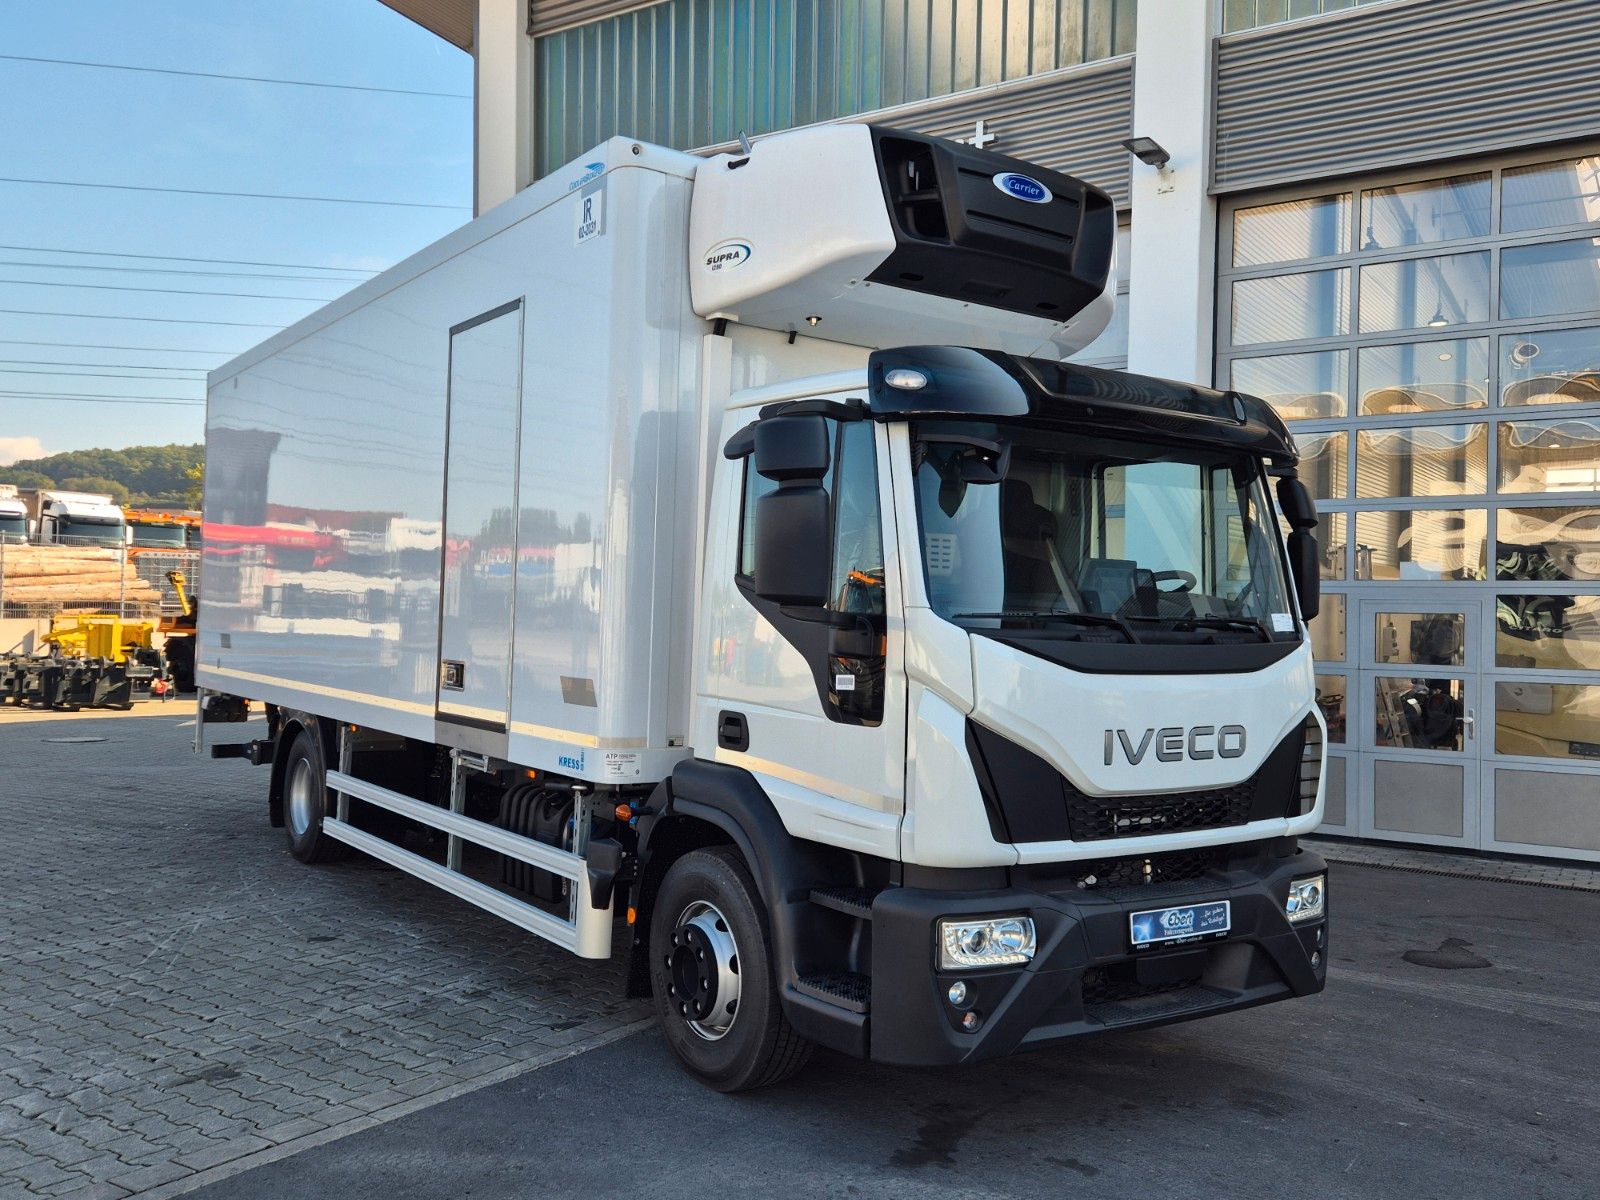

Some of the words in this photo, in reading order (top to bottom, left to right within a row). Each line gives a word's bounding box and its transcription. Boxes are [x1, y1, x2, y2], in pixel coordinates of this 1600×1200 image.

[1008, 179, 1040, 196] Carrier
[583, 197, 592, 224] IR
[706, 251, 740, 266] SUPRA
[1103, 724, 1247, 766] IVECO
[558, 755, 580, 770] KRESS
